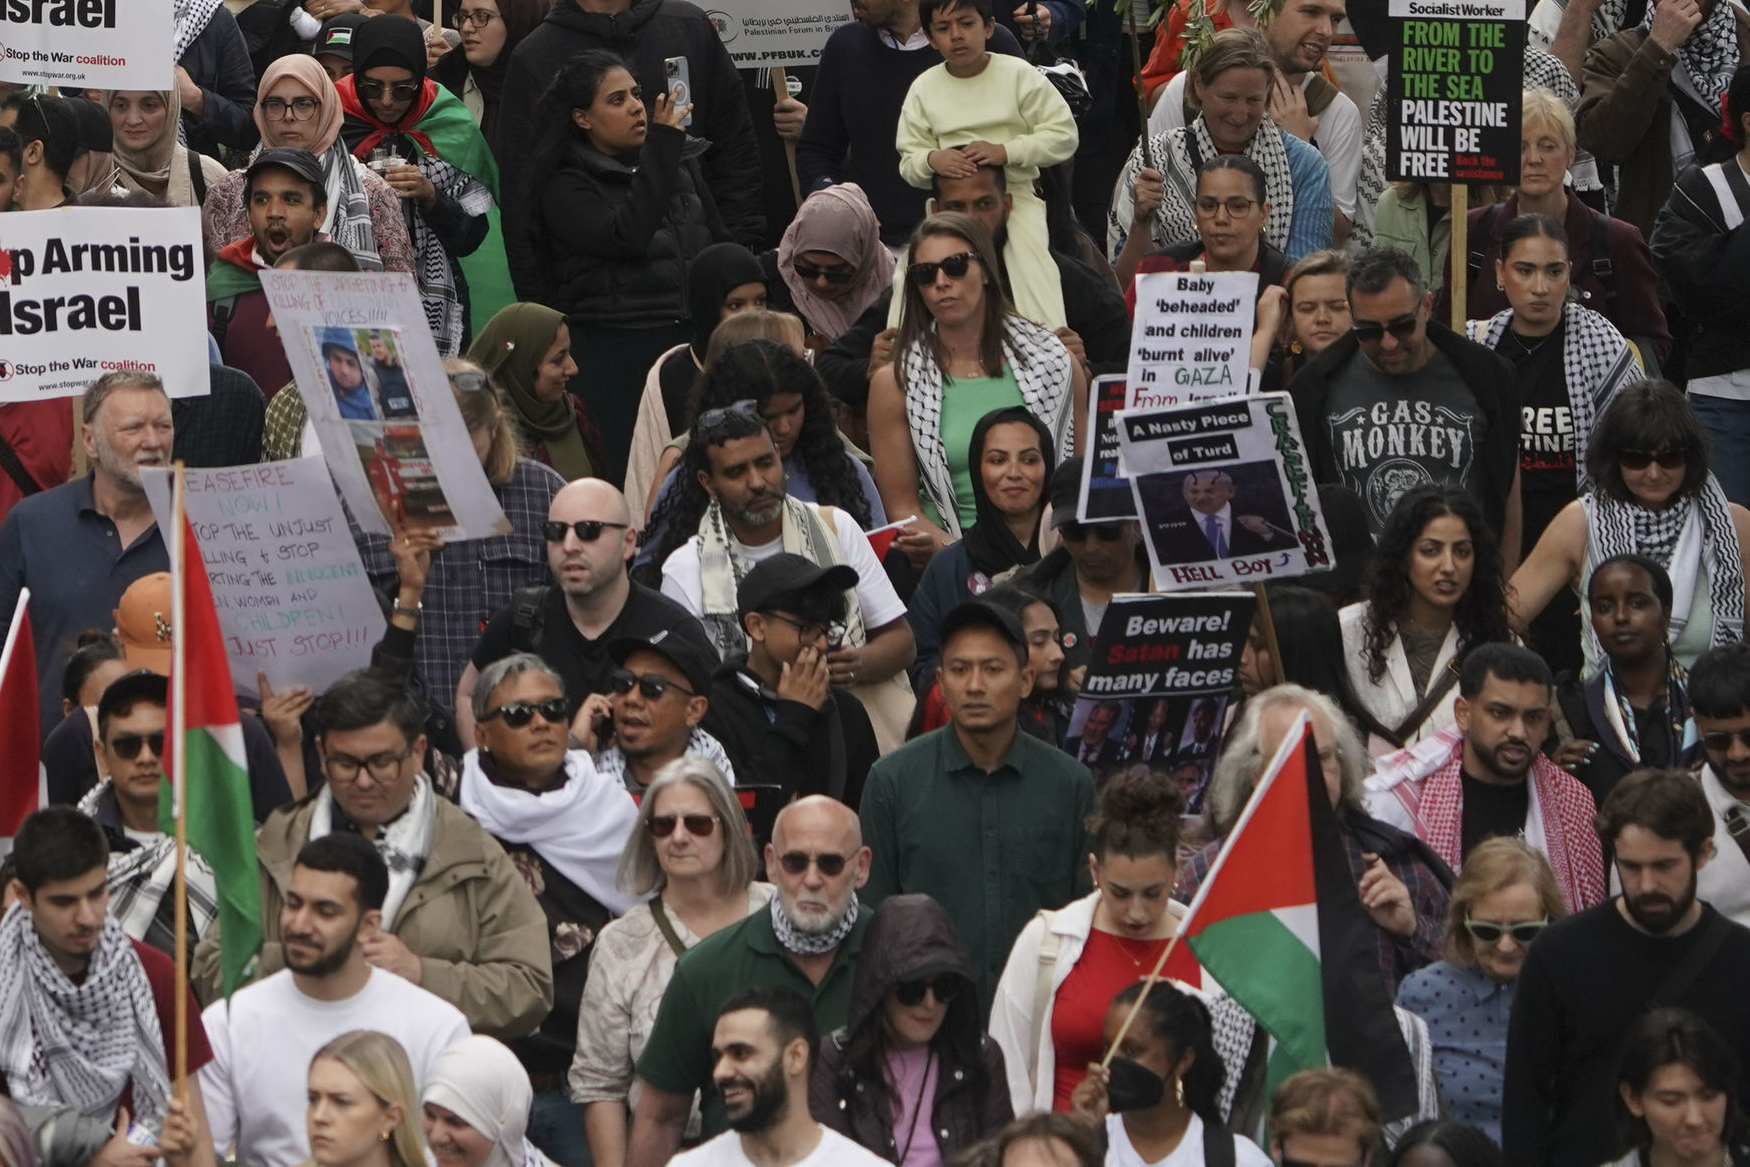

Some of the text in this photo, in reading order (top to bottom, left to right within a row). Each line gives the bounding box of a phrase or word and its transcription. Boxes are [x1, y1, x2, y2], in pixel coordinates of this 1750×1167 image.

[1403, 21, 1506, 48] FROM THE
[6, 47, 126, 66] Stop the War coalition
[1403, 46, 1494, 75] RIVER TO
[22, 69, 86, 80] www.stopwar.org.uk
[1402, 73, 1484, 101] THE SEA
[1401, 99, 1508, 128] PALESTINE
[1400, 125, 1481, 154] WILL BE
[1400, 151, 1449, 179] FREE
[1176, 276, 1215, 294] Baby
[1144, 323, 1243, 339] and children
[15, 362, 46, 377] Stop
[48, 360, 70, 373] the
[71, 356, 98, 370] War
[1141, 366, 1234, 388] in GAZA
[1132, 410, 1250, 438] A Nasty Piece
[1370, 399, 1433, 426] GAS
[1172, 441, 1233, 461] of Turd
[1342, 423, 1466, 471] MONKEY
[1169, 556, 1274, 585] HELL BOY
[1125, 610, 1232, 637] Beware!
[1107, 638, 1233, 664] Satan has
[1088, 666, 1234, 694] many faces
